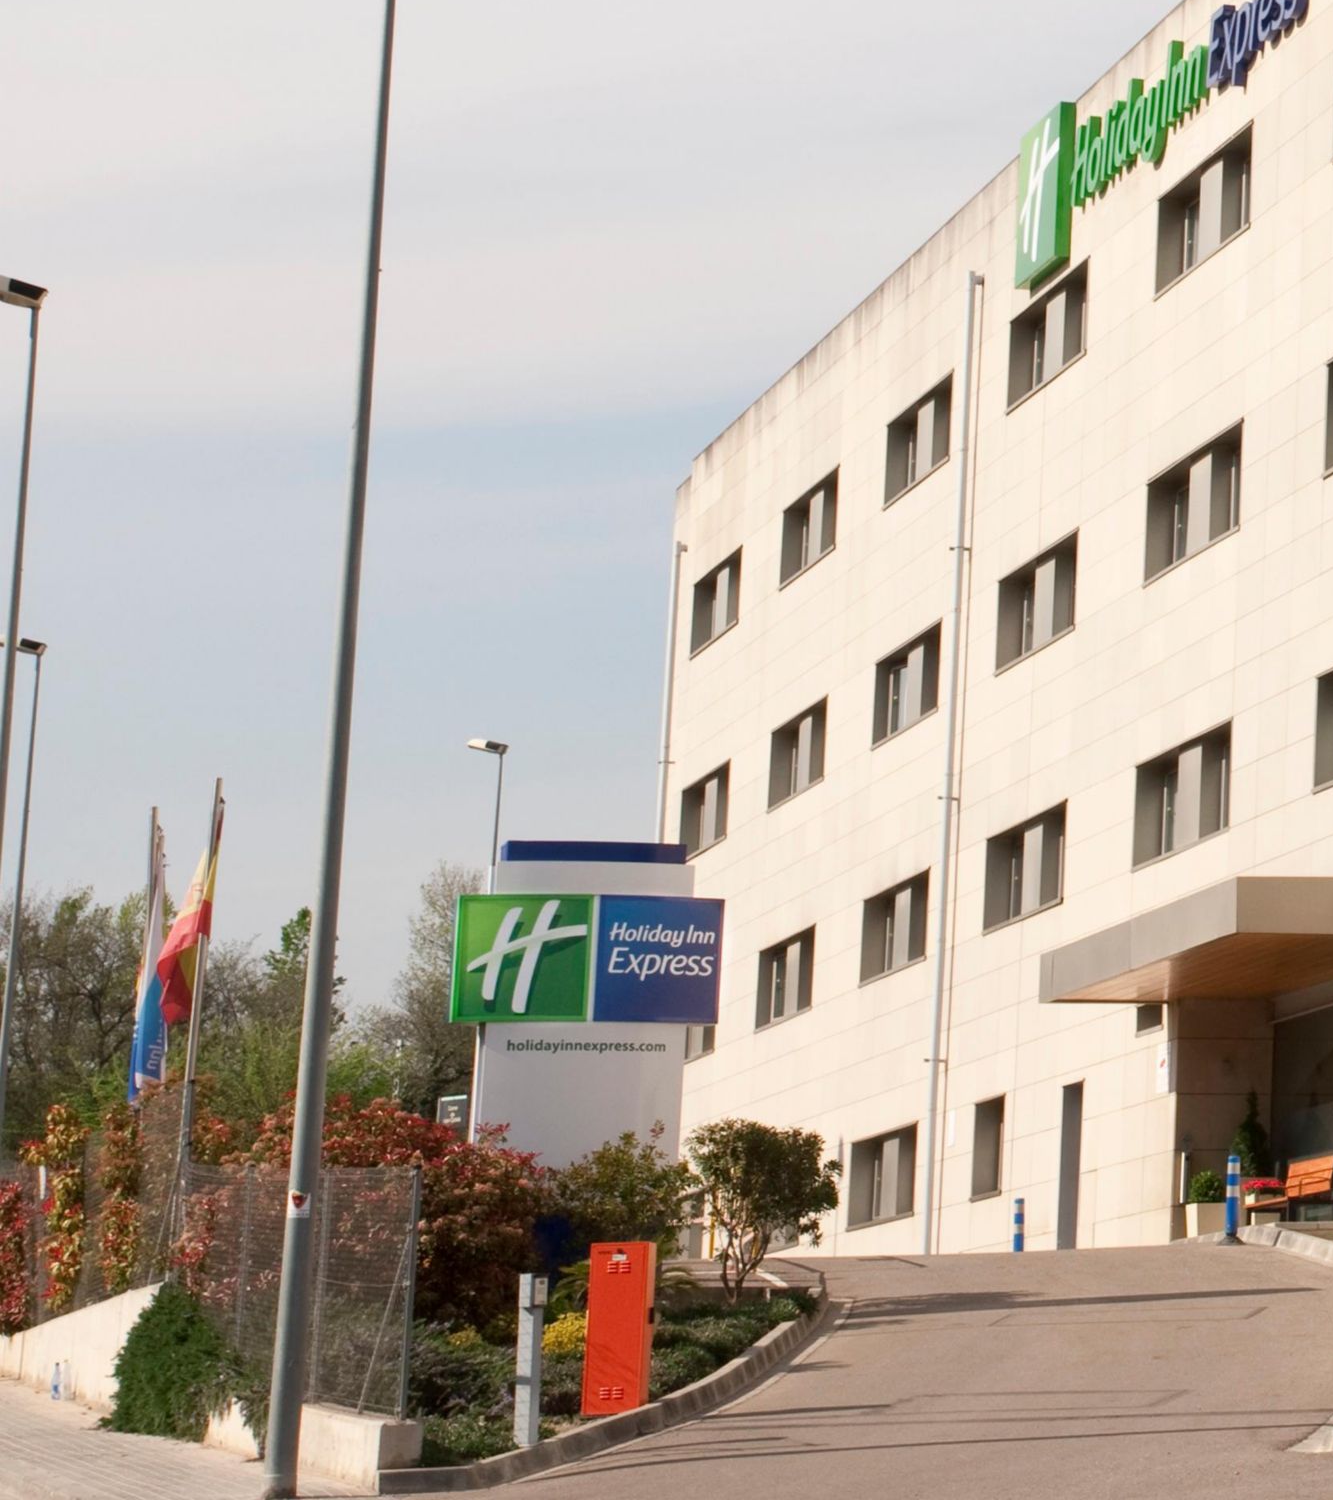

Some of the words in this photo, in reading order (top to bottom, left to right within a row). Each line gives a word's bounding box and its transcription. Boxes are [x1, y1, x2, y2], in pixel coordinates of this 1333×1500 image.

[1070, 78, 1167, 207] Holiday
[1162, 40, 1209, 128] Inn
[609, 922, 685, 948] Holiday
[687, 924, 716, 944] Inn
[608, 947, 714, 982] Express
[506, 1039, 667, 1054] holidayinnexpress.com
